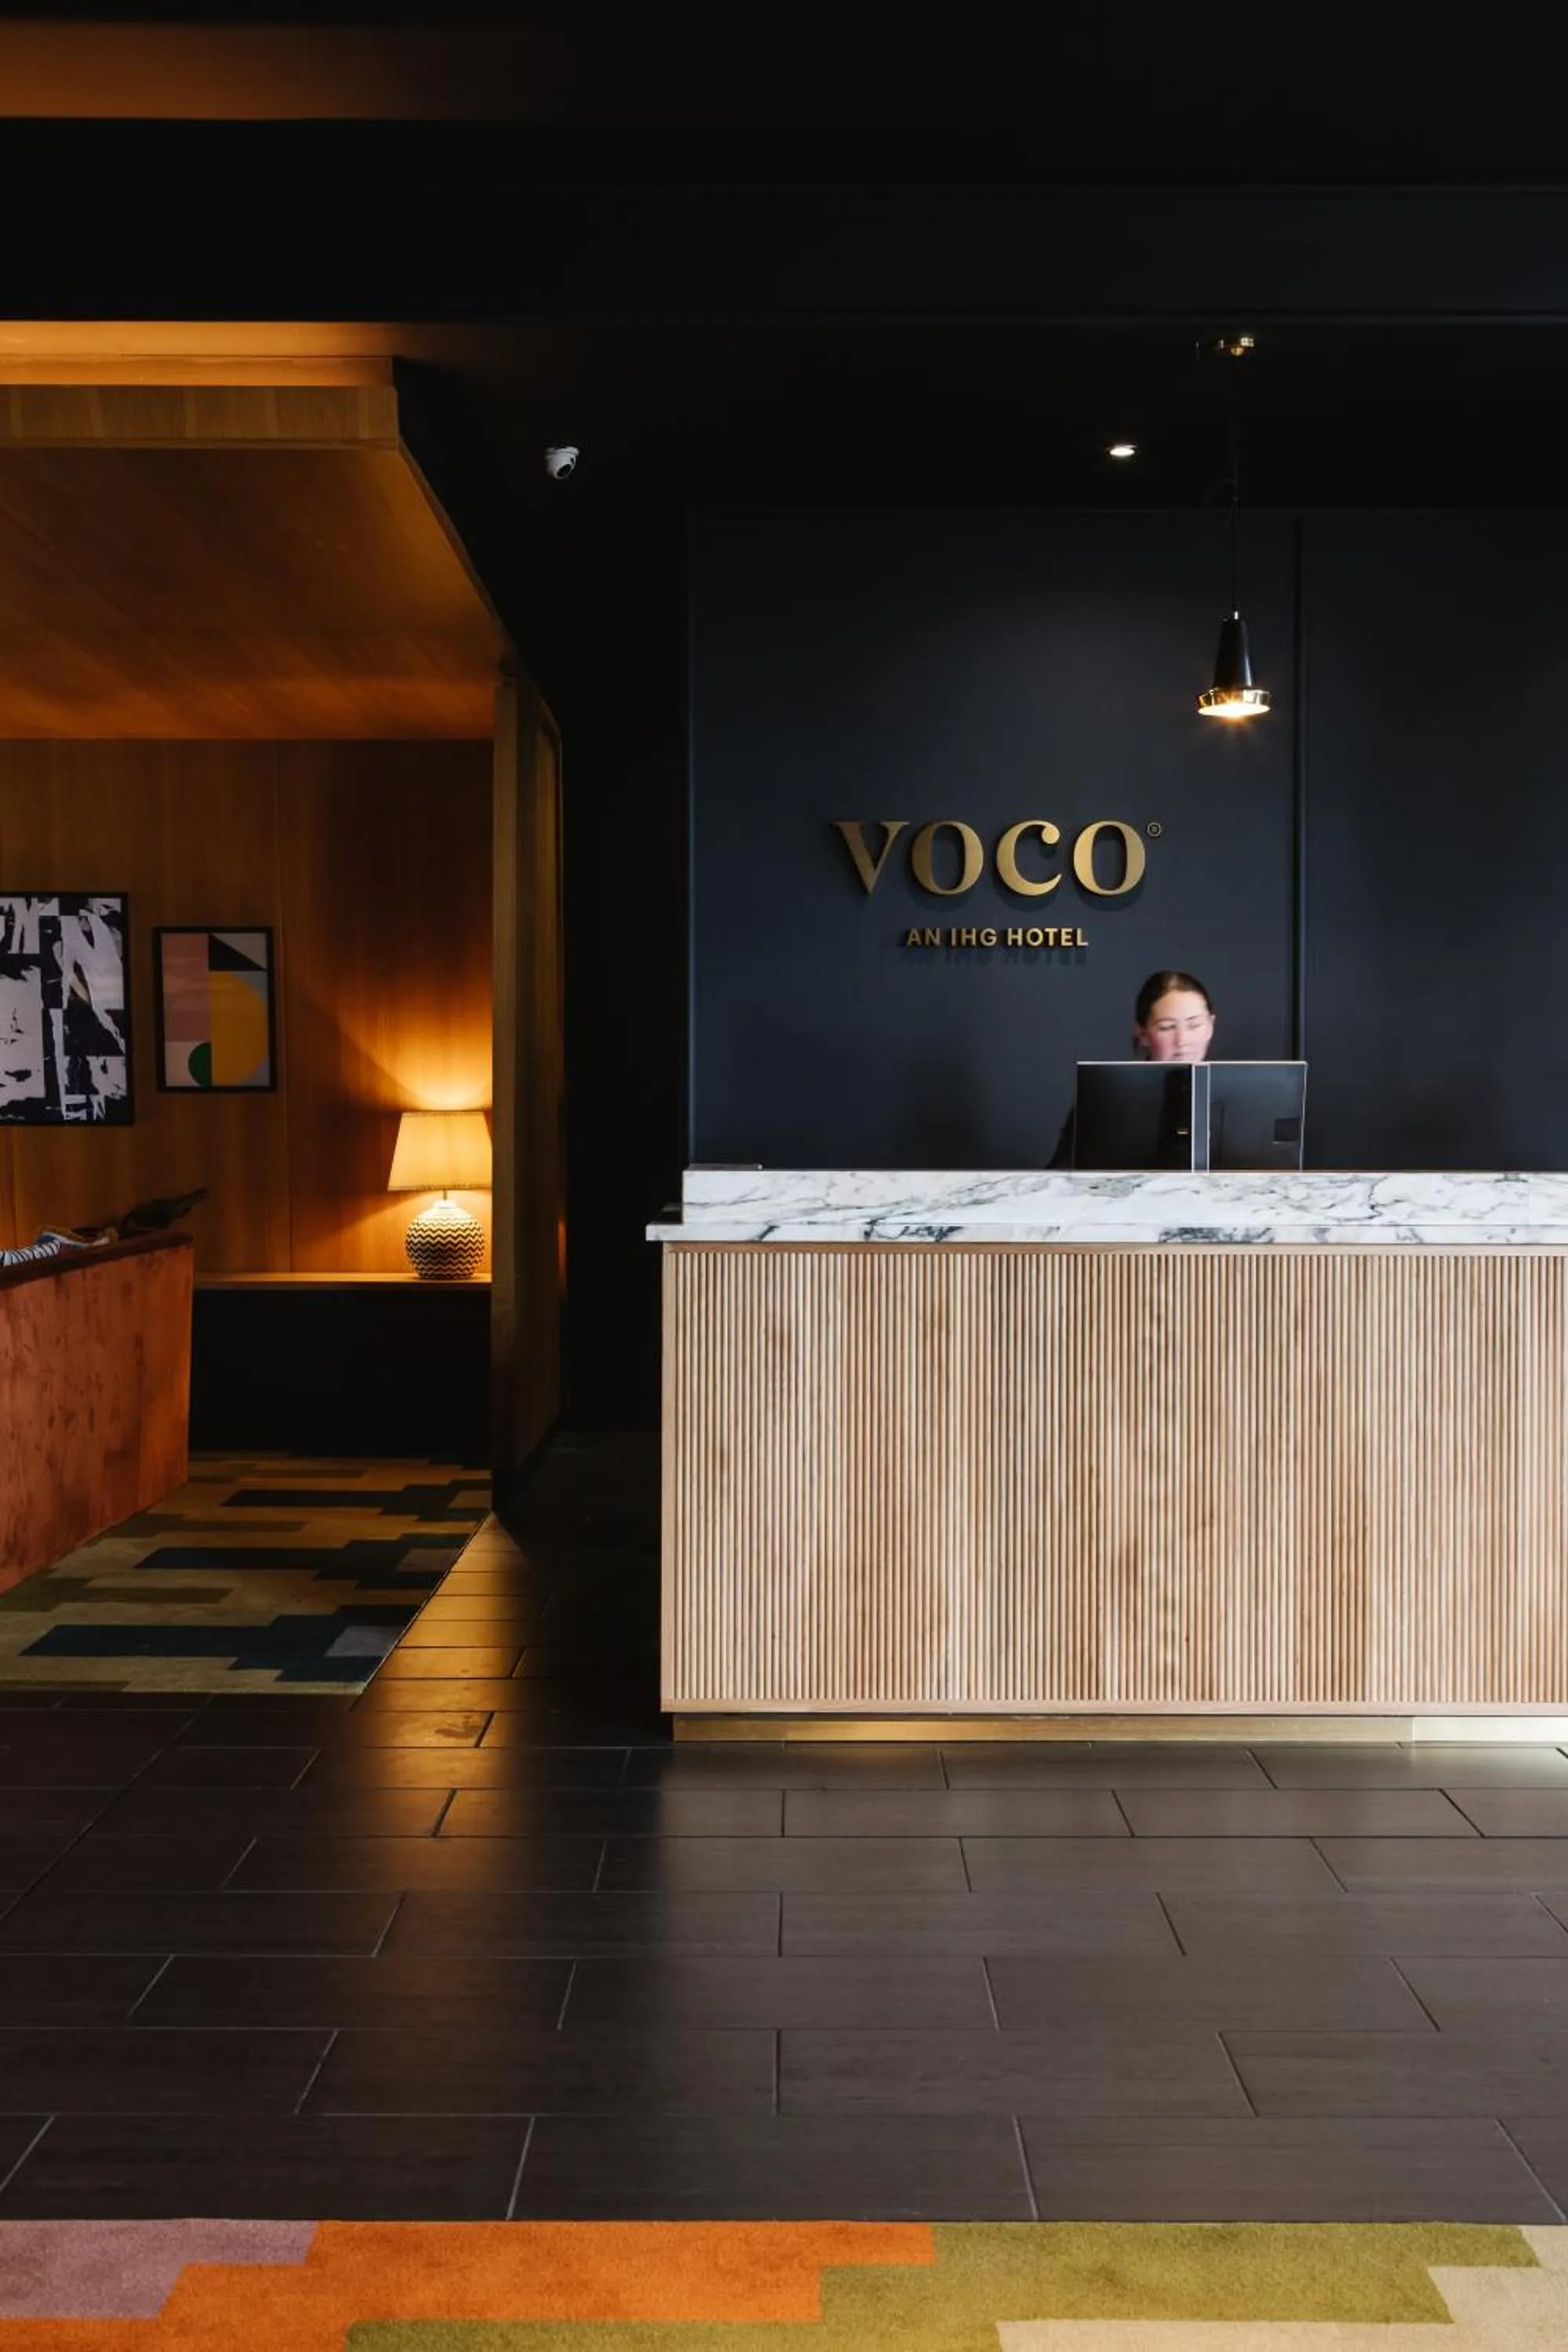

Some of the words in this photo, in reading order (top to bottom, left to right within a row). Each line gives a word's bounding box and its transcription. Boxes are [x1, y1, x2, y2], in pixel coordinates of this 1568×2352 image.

[906, 927, 941, 946] AN
[950, 927, 998, 946] IHG
[1007, 927, 1089, 946] HOTEL
